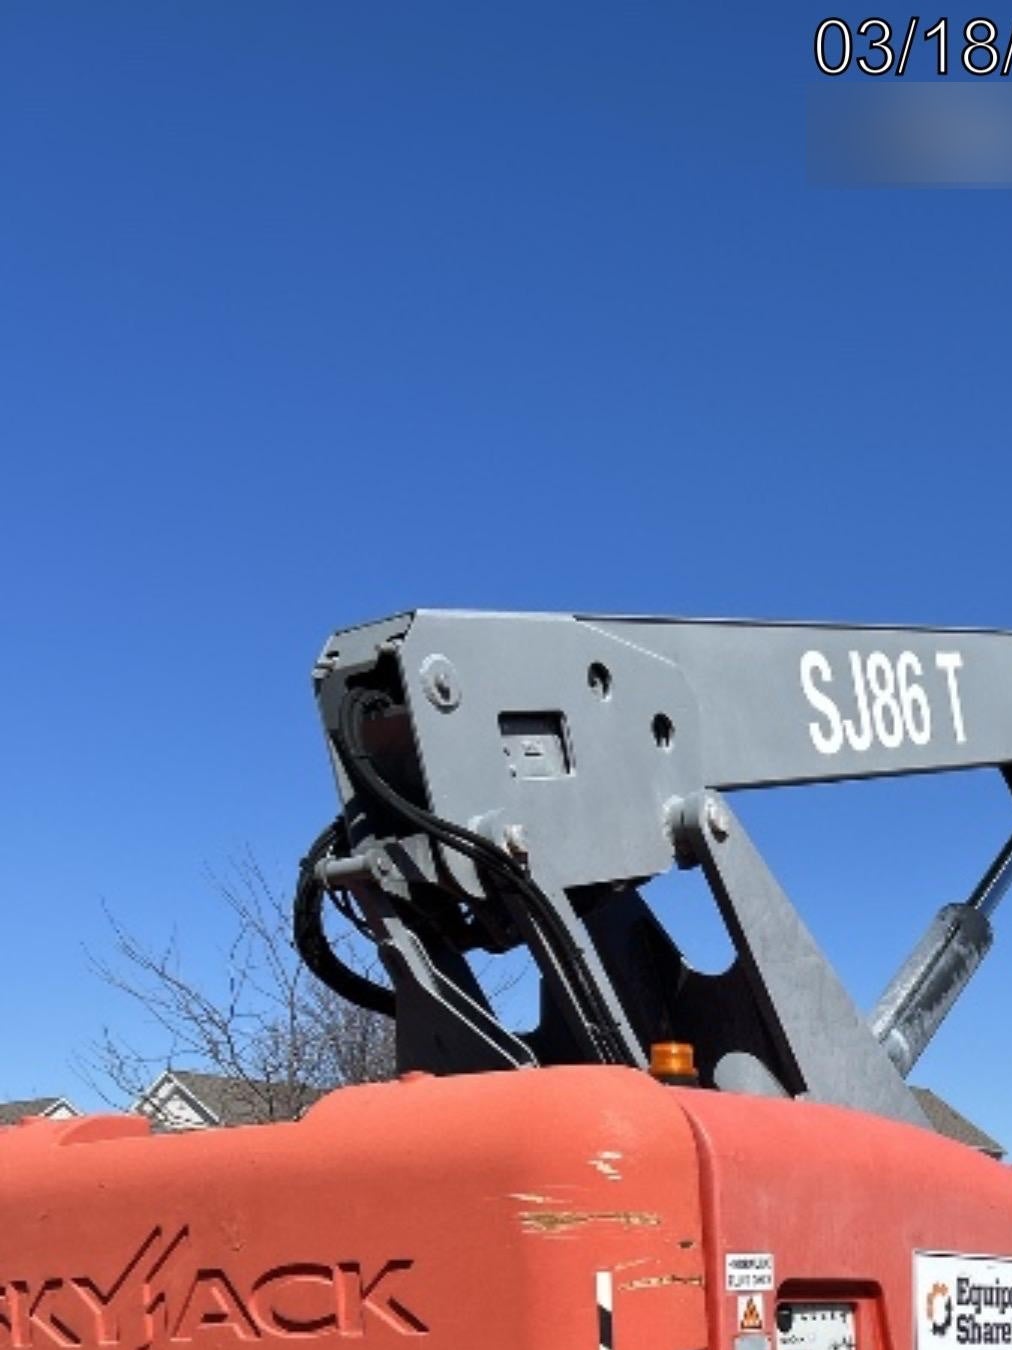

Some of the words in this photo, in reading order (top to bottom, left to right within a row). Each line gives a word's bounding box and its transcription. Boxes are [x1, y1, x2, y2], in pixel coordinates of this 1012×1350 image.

[800, 650, 931, 754] SJ86
[935, 652, 967, 744] T
[956, 1313, 1012, 1345] Share
